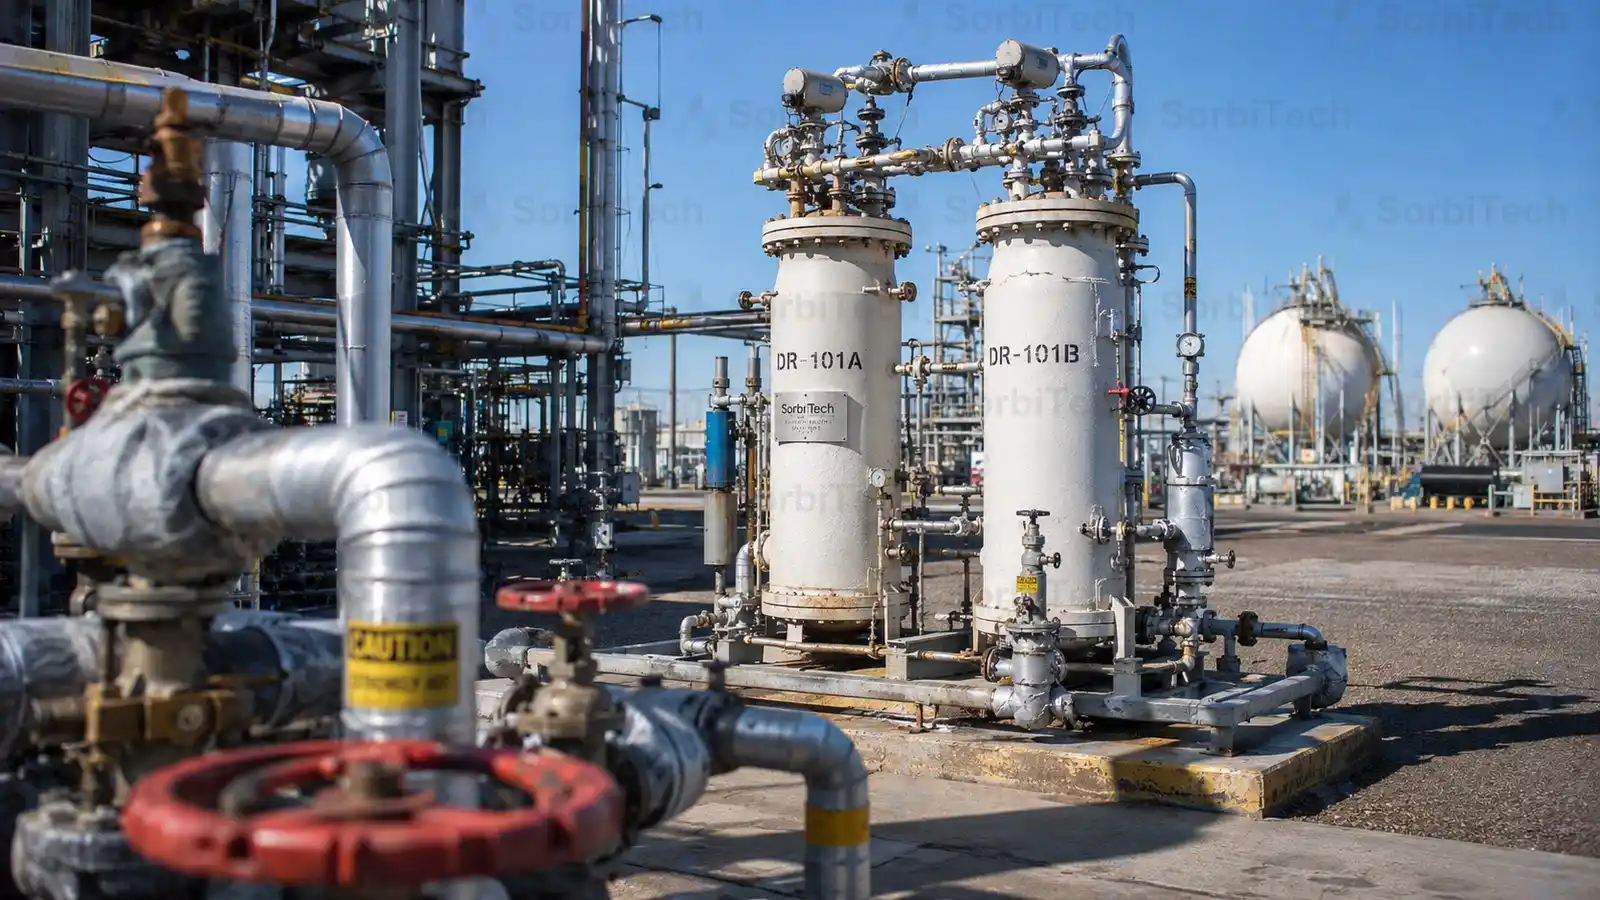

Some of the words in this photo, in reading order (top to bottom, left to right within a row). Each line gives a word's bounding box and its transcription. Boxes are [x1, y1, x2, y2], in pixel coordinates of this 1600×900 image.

[777, 351, 863, 371] DR-101A
[989, 344, 1079, 366] DR-101B
[781, 403, 835, 414] SorbiTech
[350, 630, 454, 660] CAUTION
